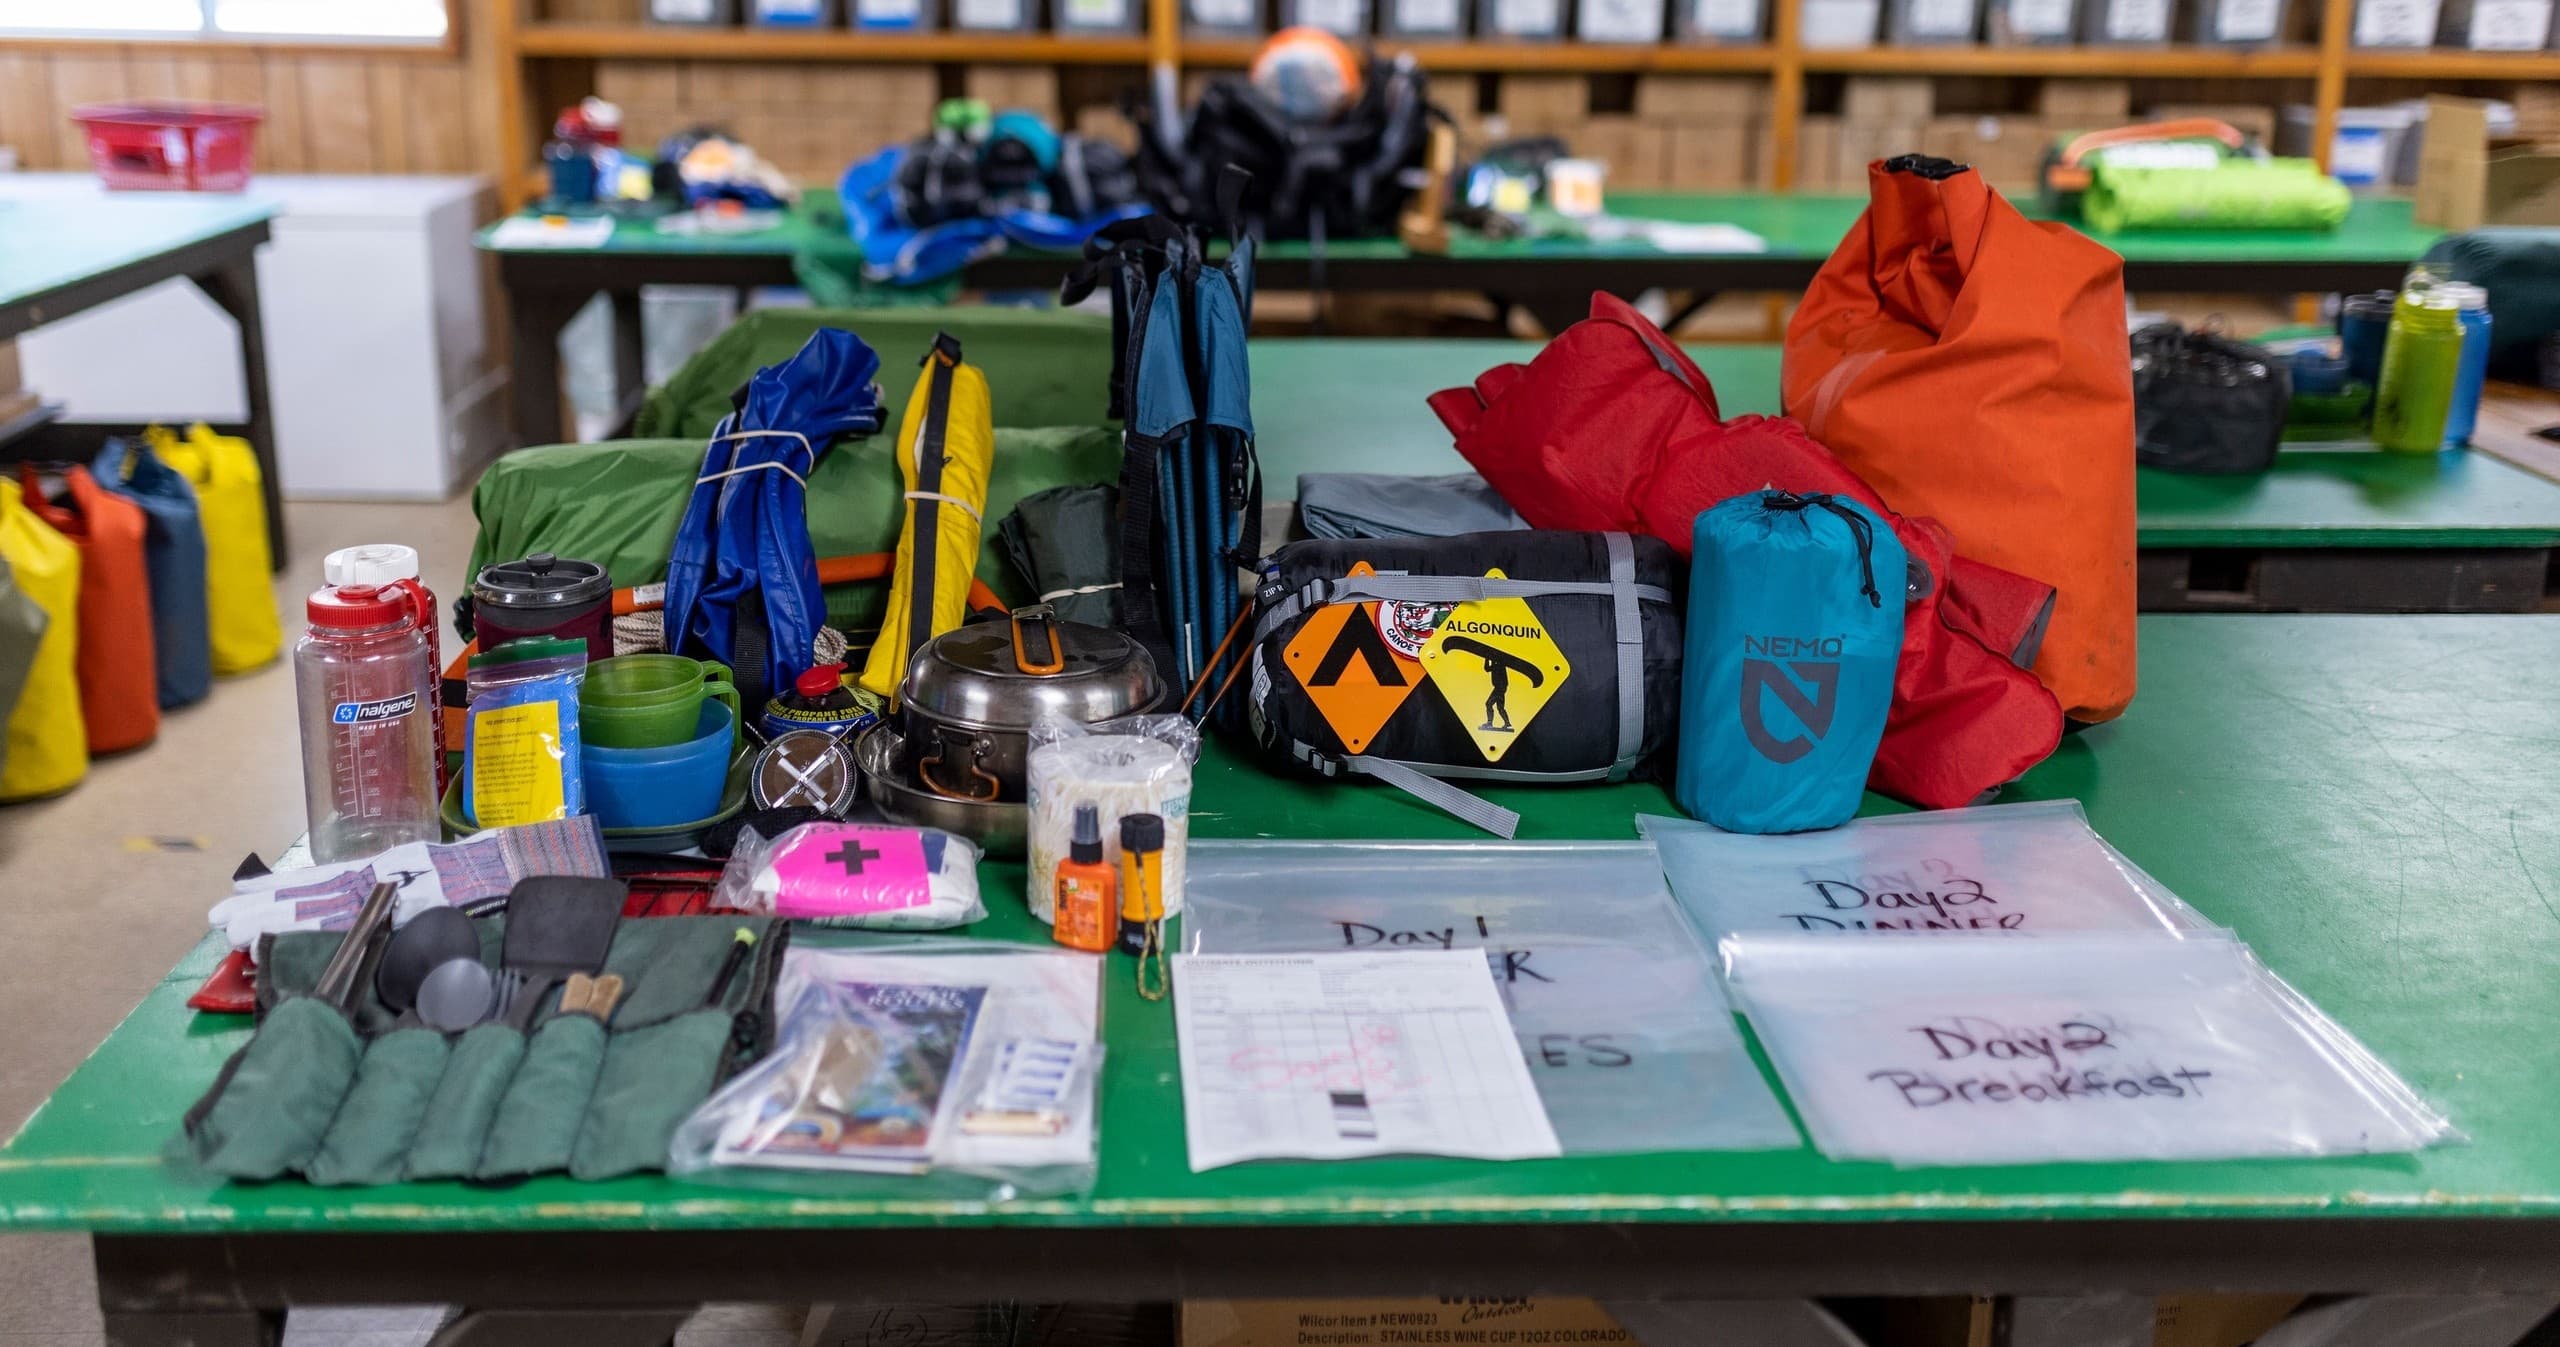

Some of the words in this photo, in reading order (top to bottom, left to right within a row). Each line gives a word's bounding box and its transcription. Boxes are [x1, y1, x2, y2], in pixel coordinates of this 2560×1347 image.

[1263, 587, 1276, 598] ZIP
[1446, 620, 1541, 639] ALGONQUIN
[1386, 628, 1414, 651] CANOE
[1745, 634, 1842, 658] NEMO
[360, 699, 415, 717] nalgene
[788, 707, 837, 717] PROPANE
[1331, 920, 1454, 950] Day
[1526, 1033, 1633, 1068] ES
[1867, 1064, 2212, 1109] Breakfast
[1299, 1313, 1339, 1326] Wilcor
[1341, 1313, 1368, 1326] Item
[1380, 1331, 1450, 1343] STAINLESS
[1454, 1331, 1486, 1343] WINE
[1490, 1330, 1516, 1342] CUP
[1553, 1329, 1627, 1342] COLORADO
